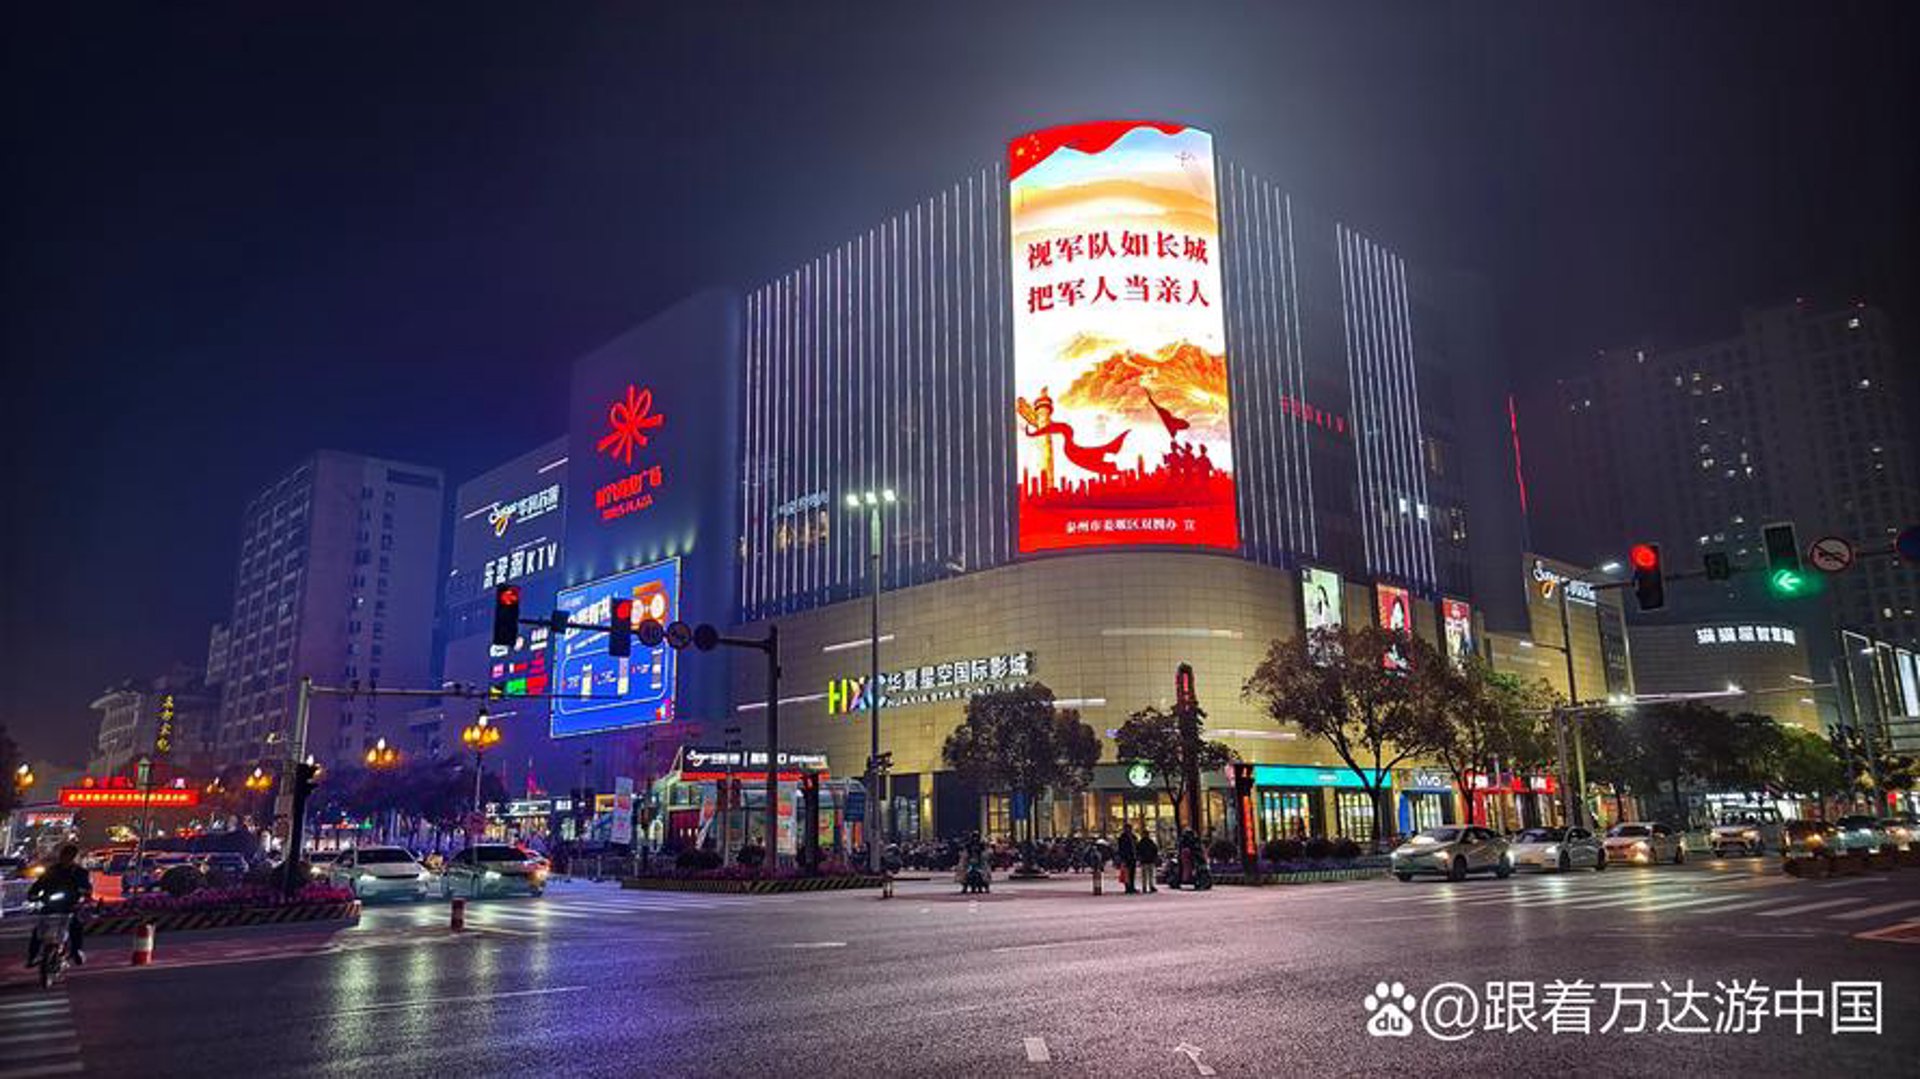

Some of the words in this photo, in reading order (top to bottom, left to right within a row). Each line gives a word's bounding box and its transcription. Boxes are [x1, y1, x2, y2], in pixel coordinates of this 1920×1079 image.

[1028, 230, 1209, 270] 视军队如长城
[1027, 275, 1210, 314] 把军人当亲人
[887, 652, 1029, 695] 华夏星空国际影城
[1416, 771, 1441, 787] vivo
